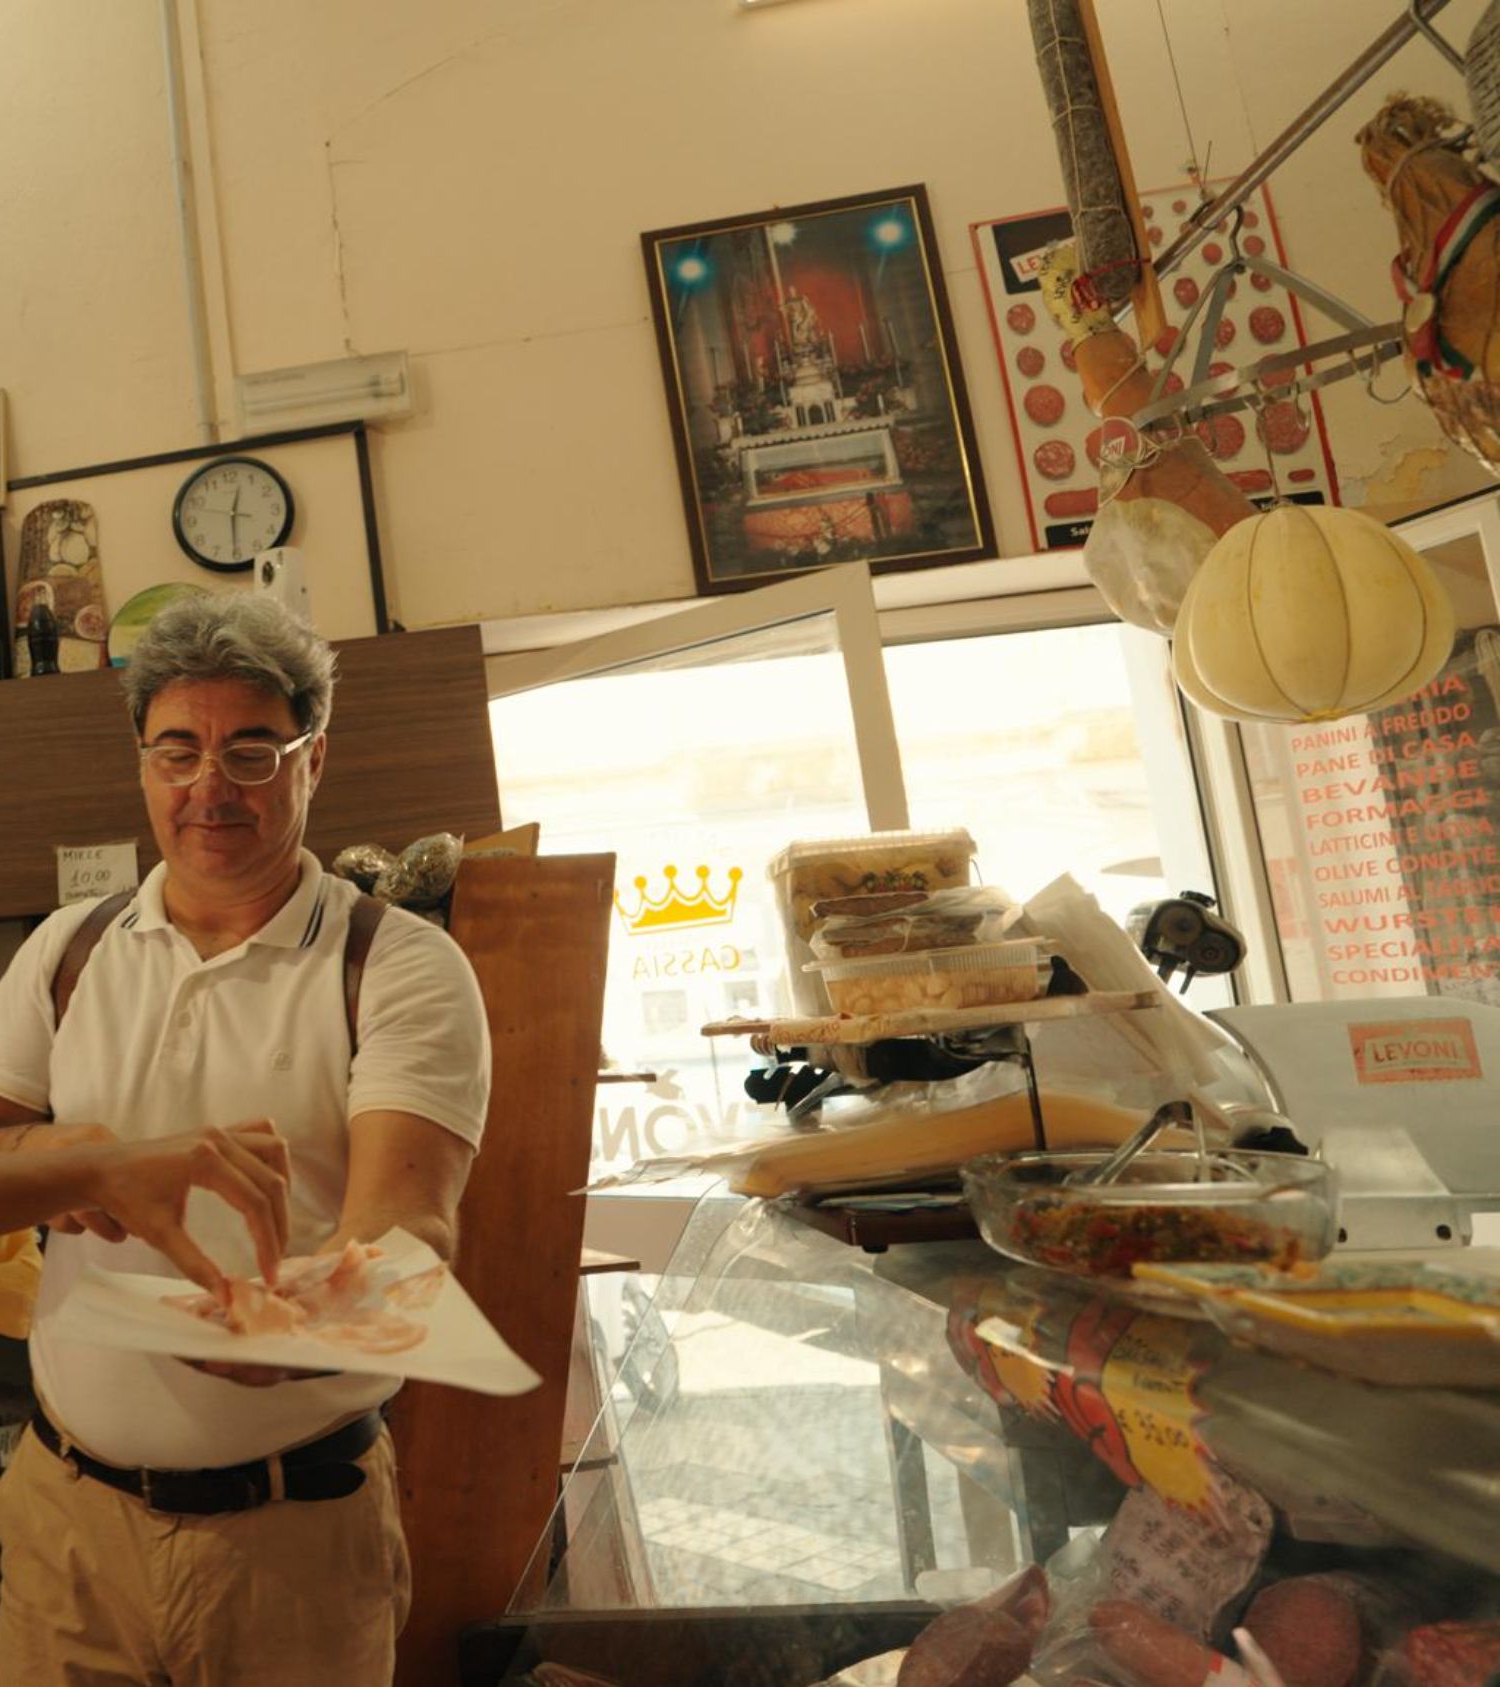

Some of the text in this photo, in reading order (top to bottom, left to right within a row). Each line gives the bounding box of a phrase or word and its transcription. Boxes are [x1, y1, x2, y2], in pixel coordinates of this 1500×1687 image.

[222, 470, 238, 484] 12
[1291, 702, 1472, 753] PANINI A FREDDO
[1296, 731, 1477, 779] PANE DI CASA
[1302, 759, 1479, 804] BEVANDE
[1306, 787, 1490, 829] FORMAGGI
[1310, 818, 1493, 857] LATTICINI E UOVA
[1314, 847, 1497, 882] OLIVE CONDITE
[1318, 887, 1390, 908] SALUMI
[1397, 884, 1421, 900] AL
[1372, 1040, 1458, 1062] LEVONI
